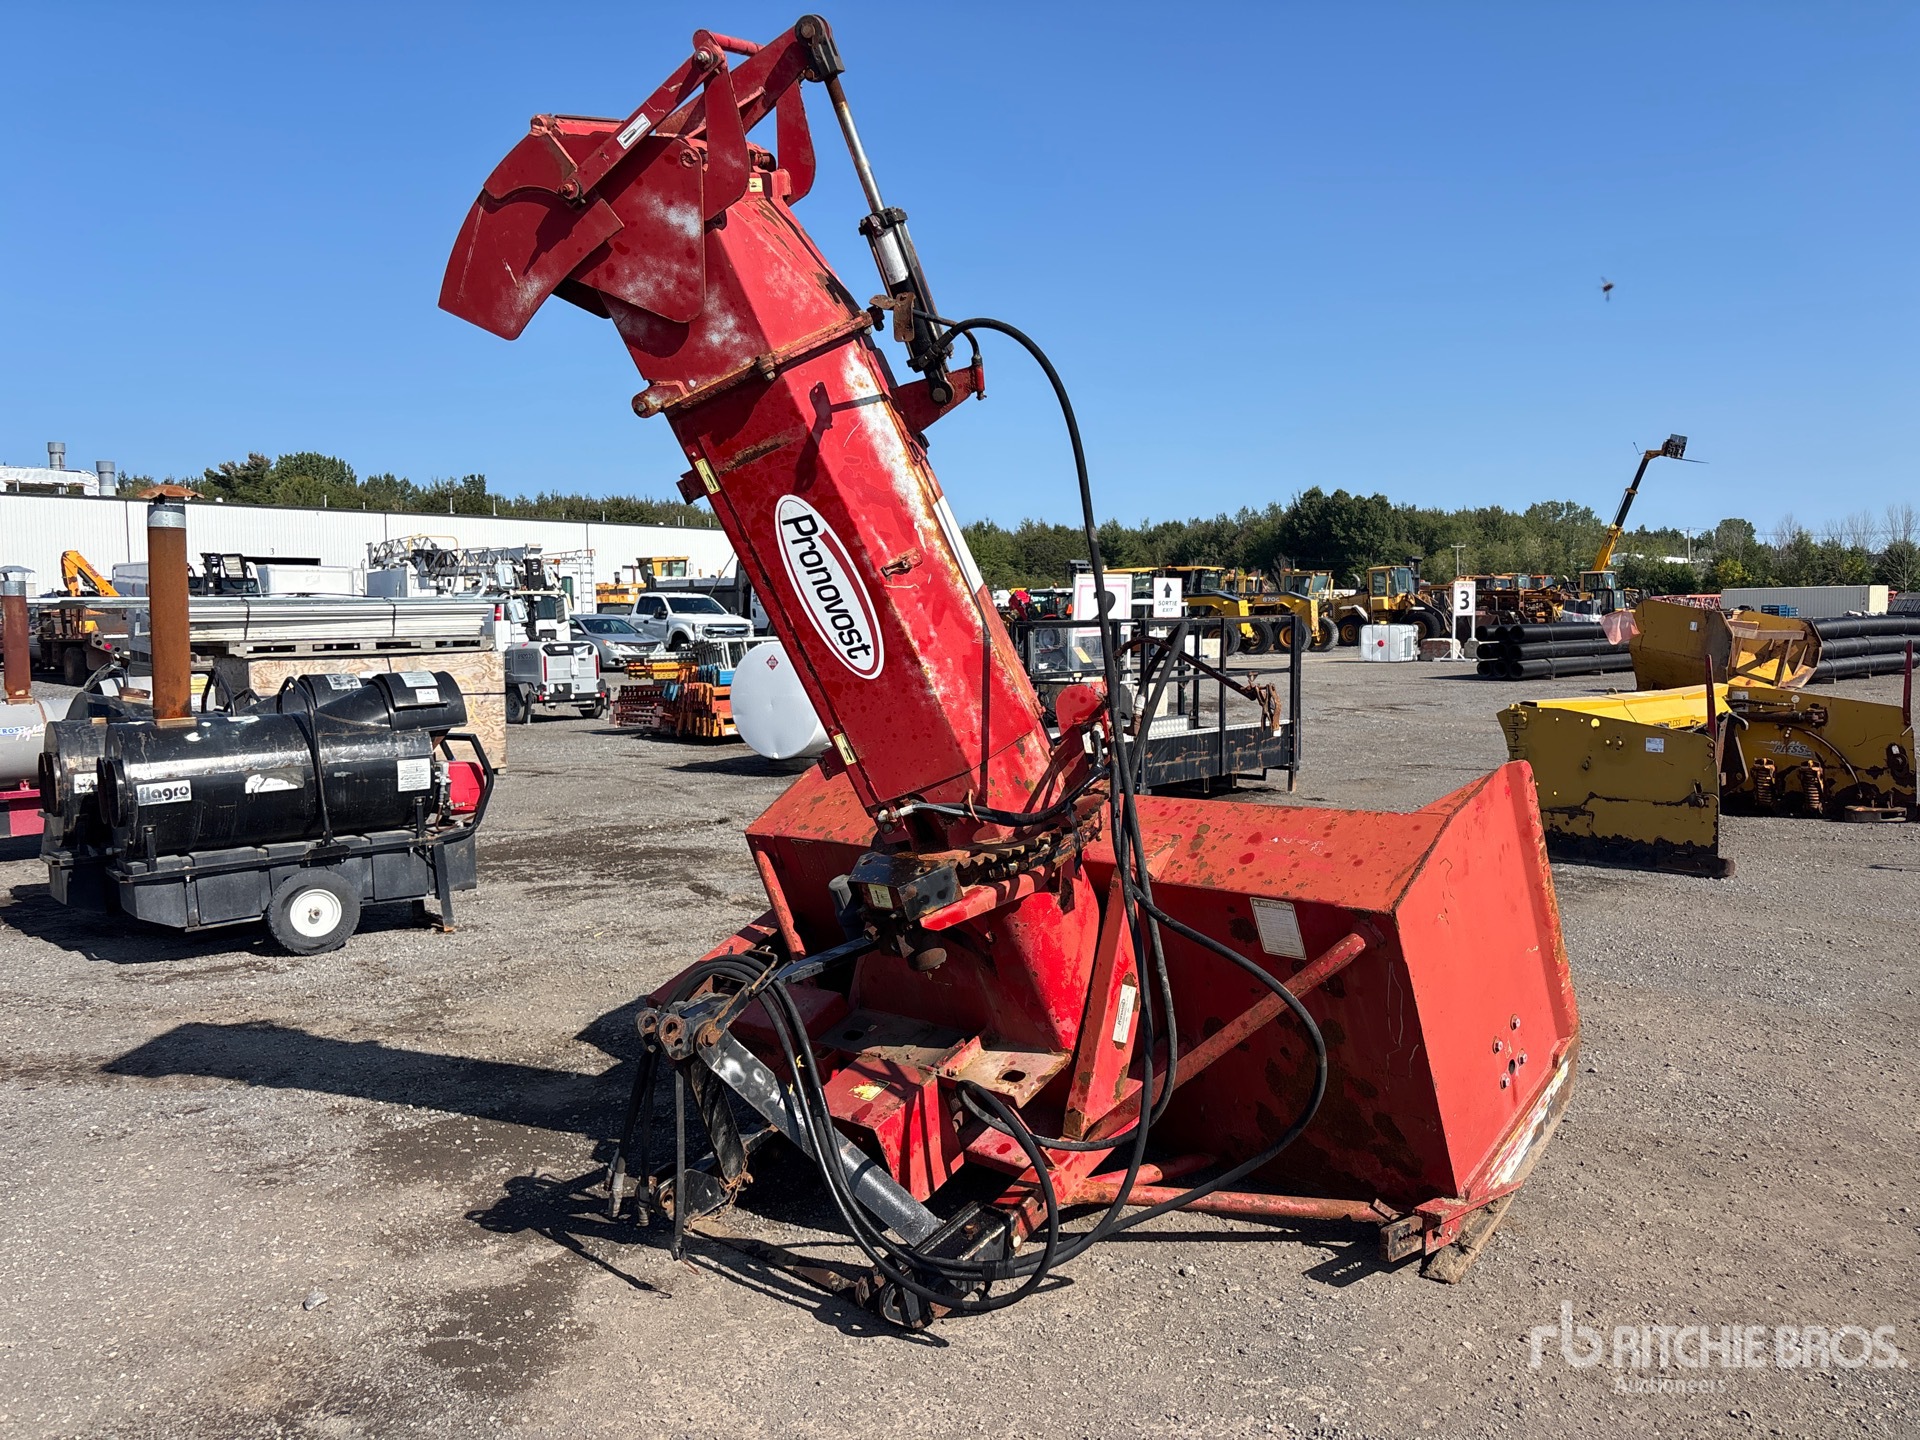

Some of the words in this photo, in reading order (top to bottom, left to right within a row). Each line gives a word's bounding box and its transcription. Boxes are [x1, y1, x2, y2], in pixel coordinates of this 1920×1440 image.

[270, 547, 275, 555] 3
[782, 513, 872, 660] Pronovost
[1459, 590, 1470, 610] 3
[139, 785, 190, 801] flagro
[1260, 901, 1293, 910] ATTENTION
